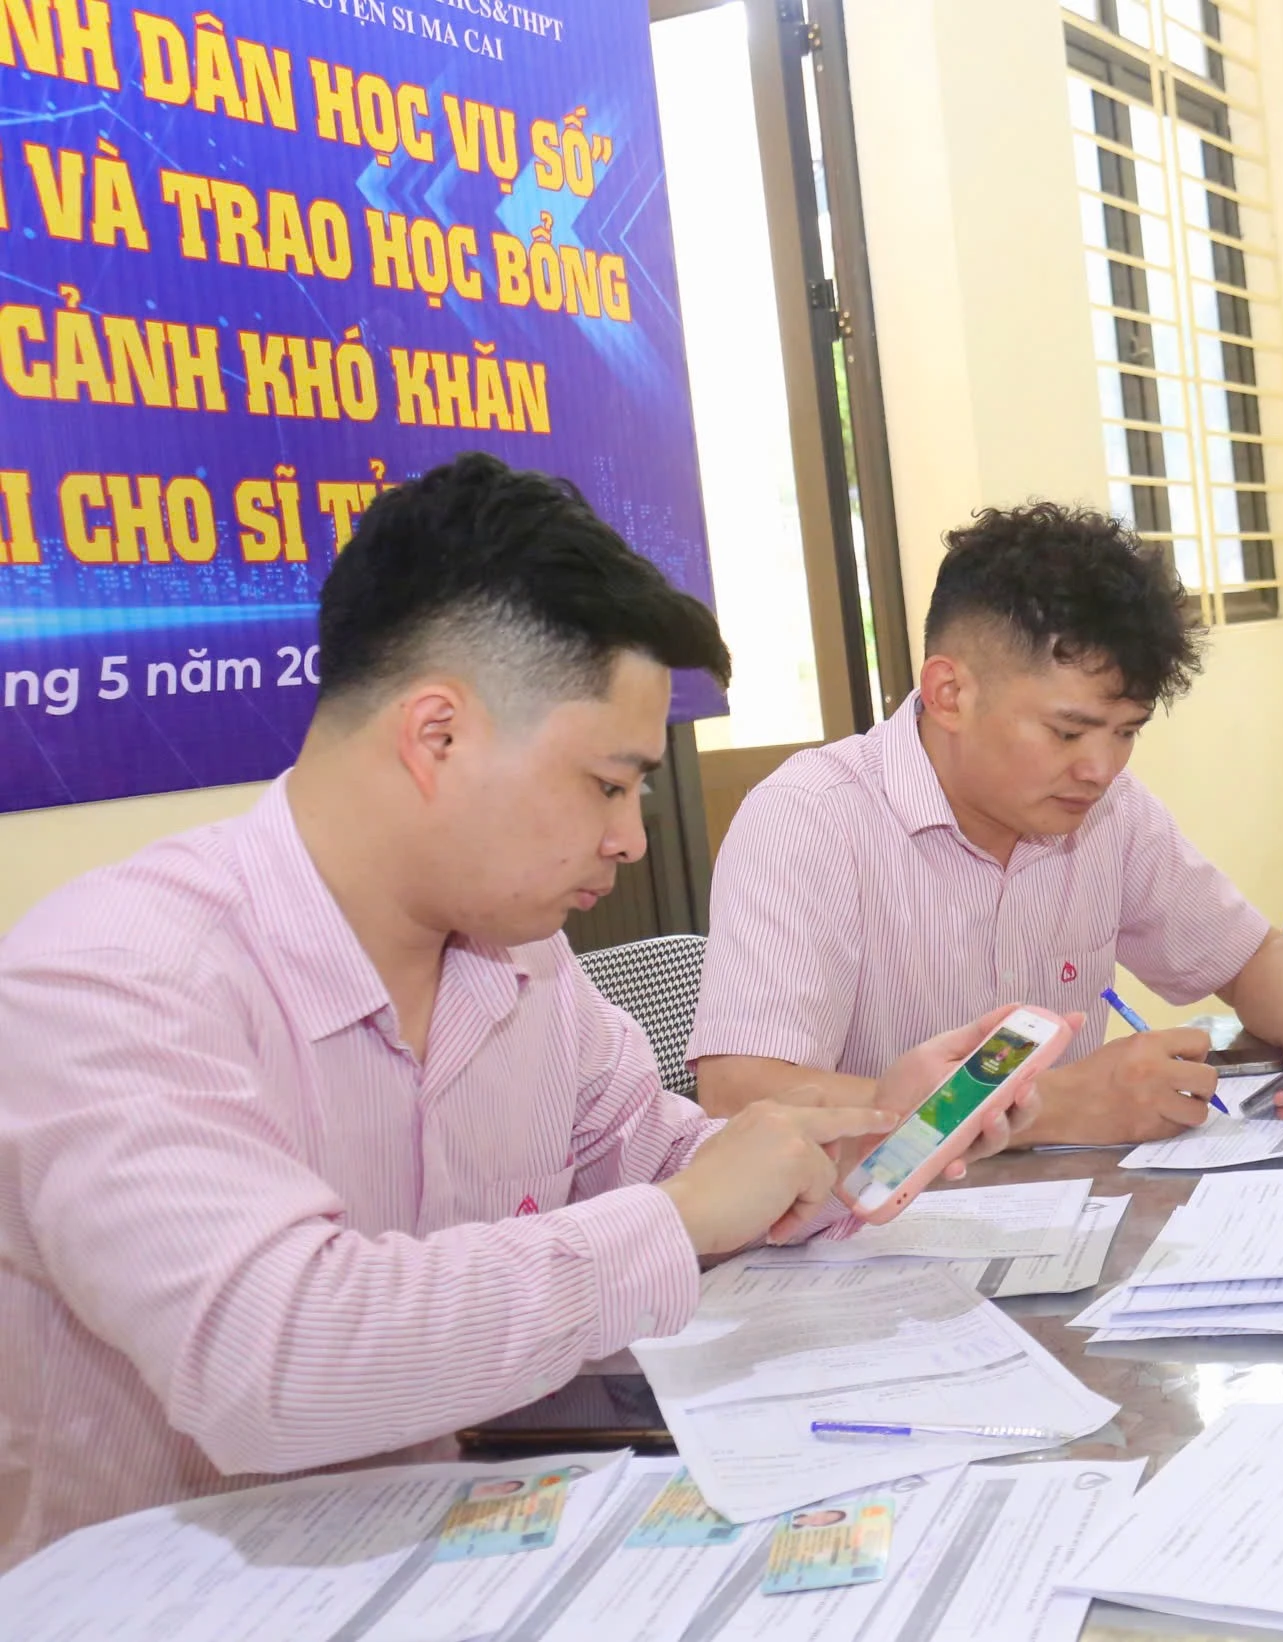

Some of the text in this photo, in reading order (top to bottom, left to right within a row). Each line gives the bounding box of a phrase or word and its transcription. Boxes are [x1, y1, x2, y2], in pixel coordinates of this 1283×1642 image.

[391, 6, 416, 35] SI
[420, 14, 459, 48] MA
[463, 28, 505, 62] CAI
[435, 0, 563, 42] CS&THPT
[132, 10, 299, 133] DÂN
[308, 58, 435, 168] HỌC
[442, 93, 520, 195] VỤ
[23, 136, 150, 252] VÀ
[160, 168, 353, 281] TRAO
[365, 208, 484, 309] HỌC
[490, 210, 632, 323] BỔNG
[0, 285, 552, 434] CẢNH KHÓ KHĂN
[0, 469, 42, 564] I
[59, 472, 218, 564] CHO
[234, 464, 308, 563] SĨ
[98, 655, 129, 700] 5
[147, 648, 262, 697] năm
